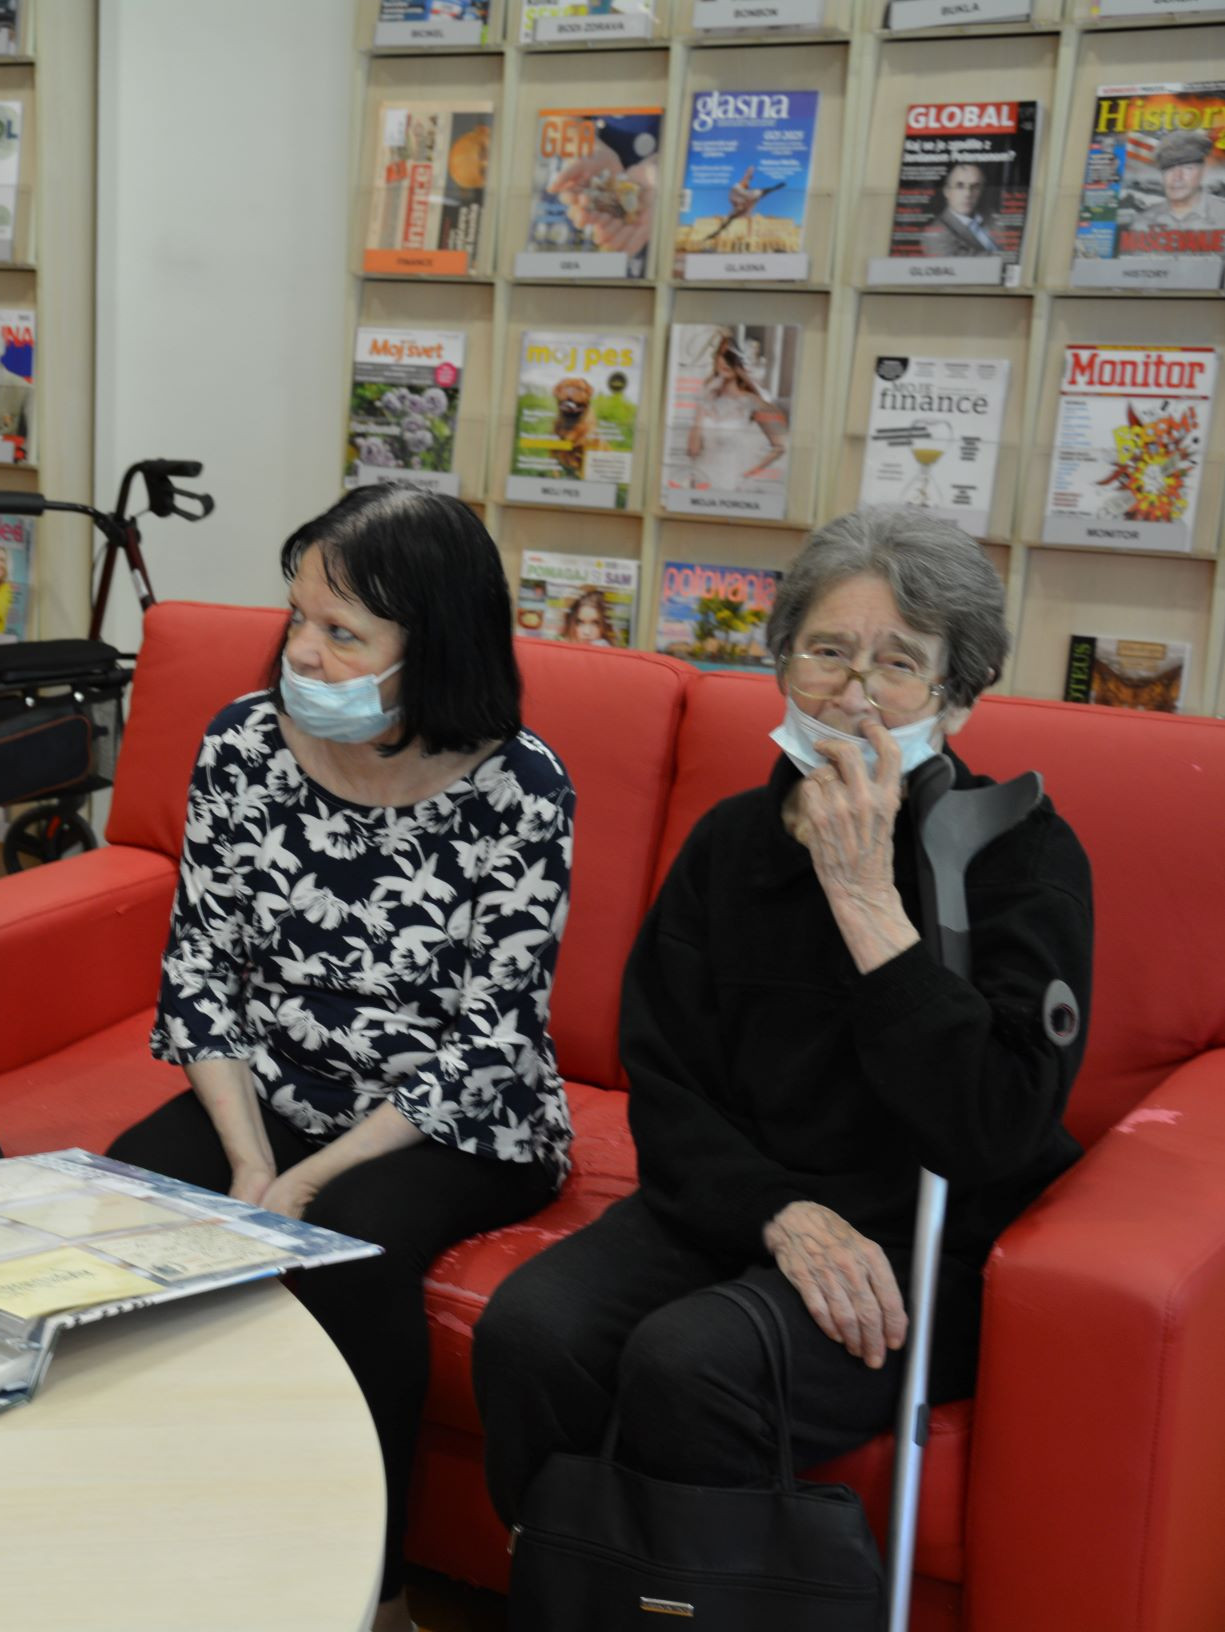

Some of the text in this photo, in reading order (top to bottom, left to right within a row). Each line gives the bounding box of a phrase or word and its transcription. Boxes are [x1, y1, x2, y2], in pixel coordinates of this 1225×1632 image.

[693, 90, 790, 132] glasna
[907, 104, 1016, 129] GLOBAL
[540, 120, 595, 159] GEA
[526, 345, 634, 373] moj pes
[1067, 352, 1206, 390] Monitor
[878, 386, 989, 416] finance
[1086, 527, 1141, 541] MONITOR
[604, 572, 632, 586] SAM
